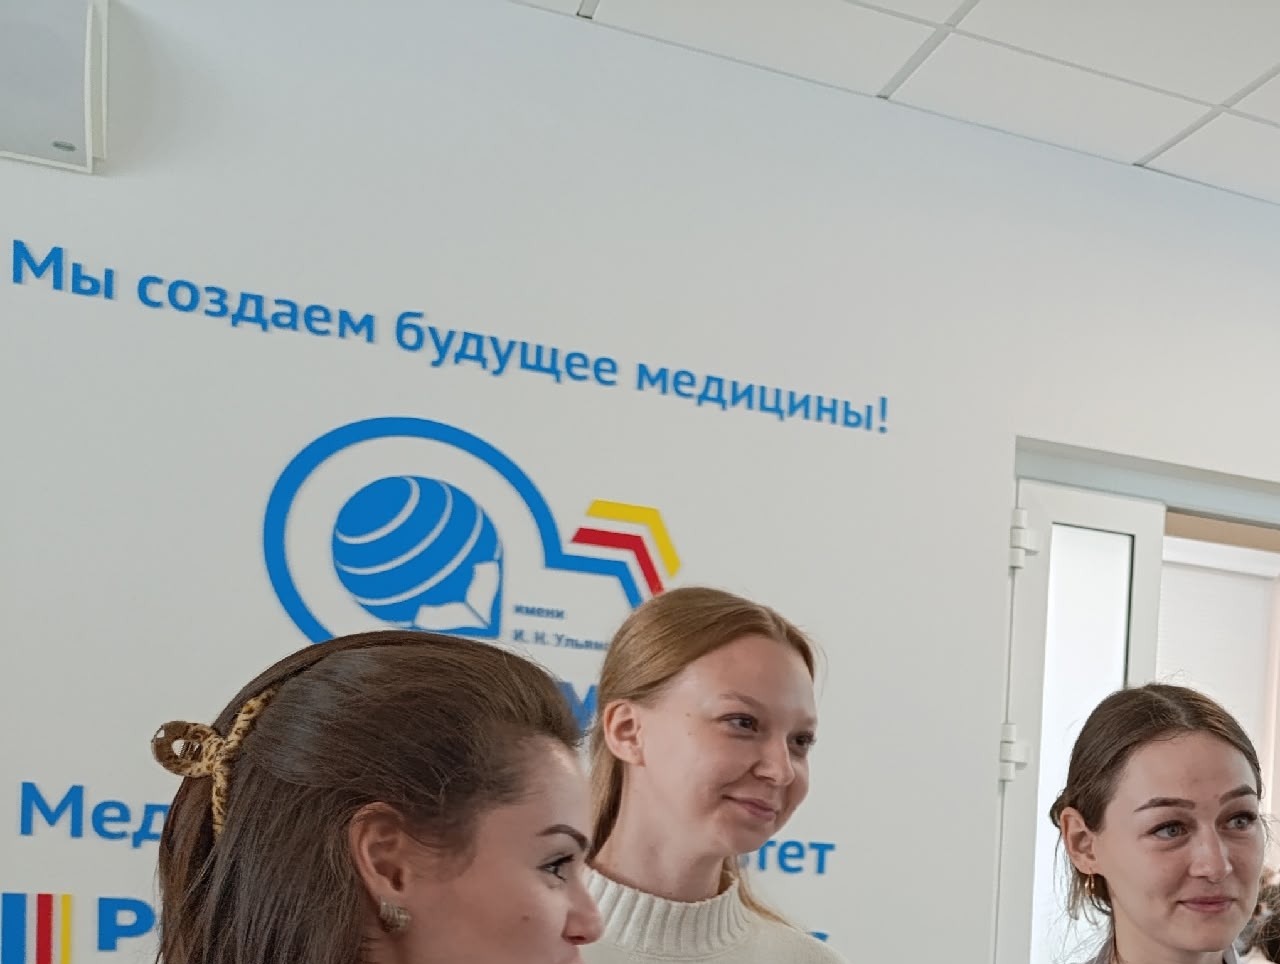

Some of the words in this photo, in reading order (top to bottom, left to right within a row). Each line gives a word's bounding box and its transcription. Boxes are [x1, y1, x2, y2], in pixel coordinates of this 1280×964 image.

[11, 239, 115, 300] Мы
[136, 274, 376, 344] создаем
[394, 310, 619, 387] будущее
[636, 362, 889, 433] медицины!
